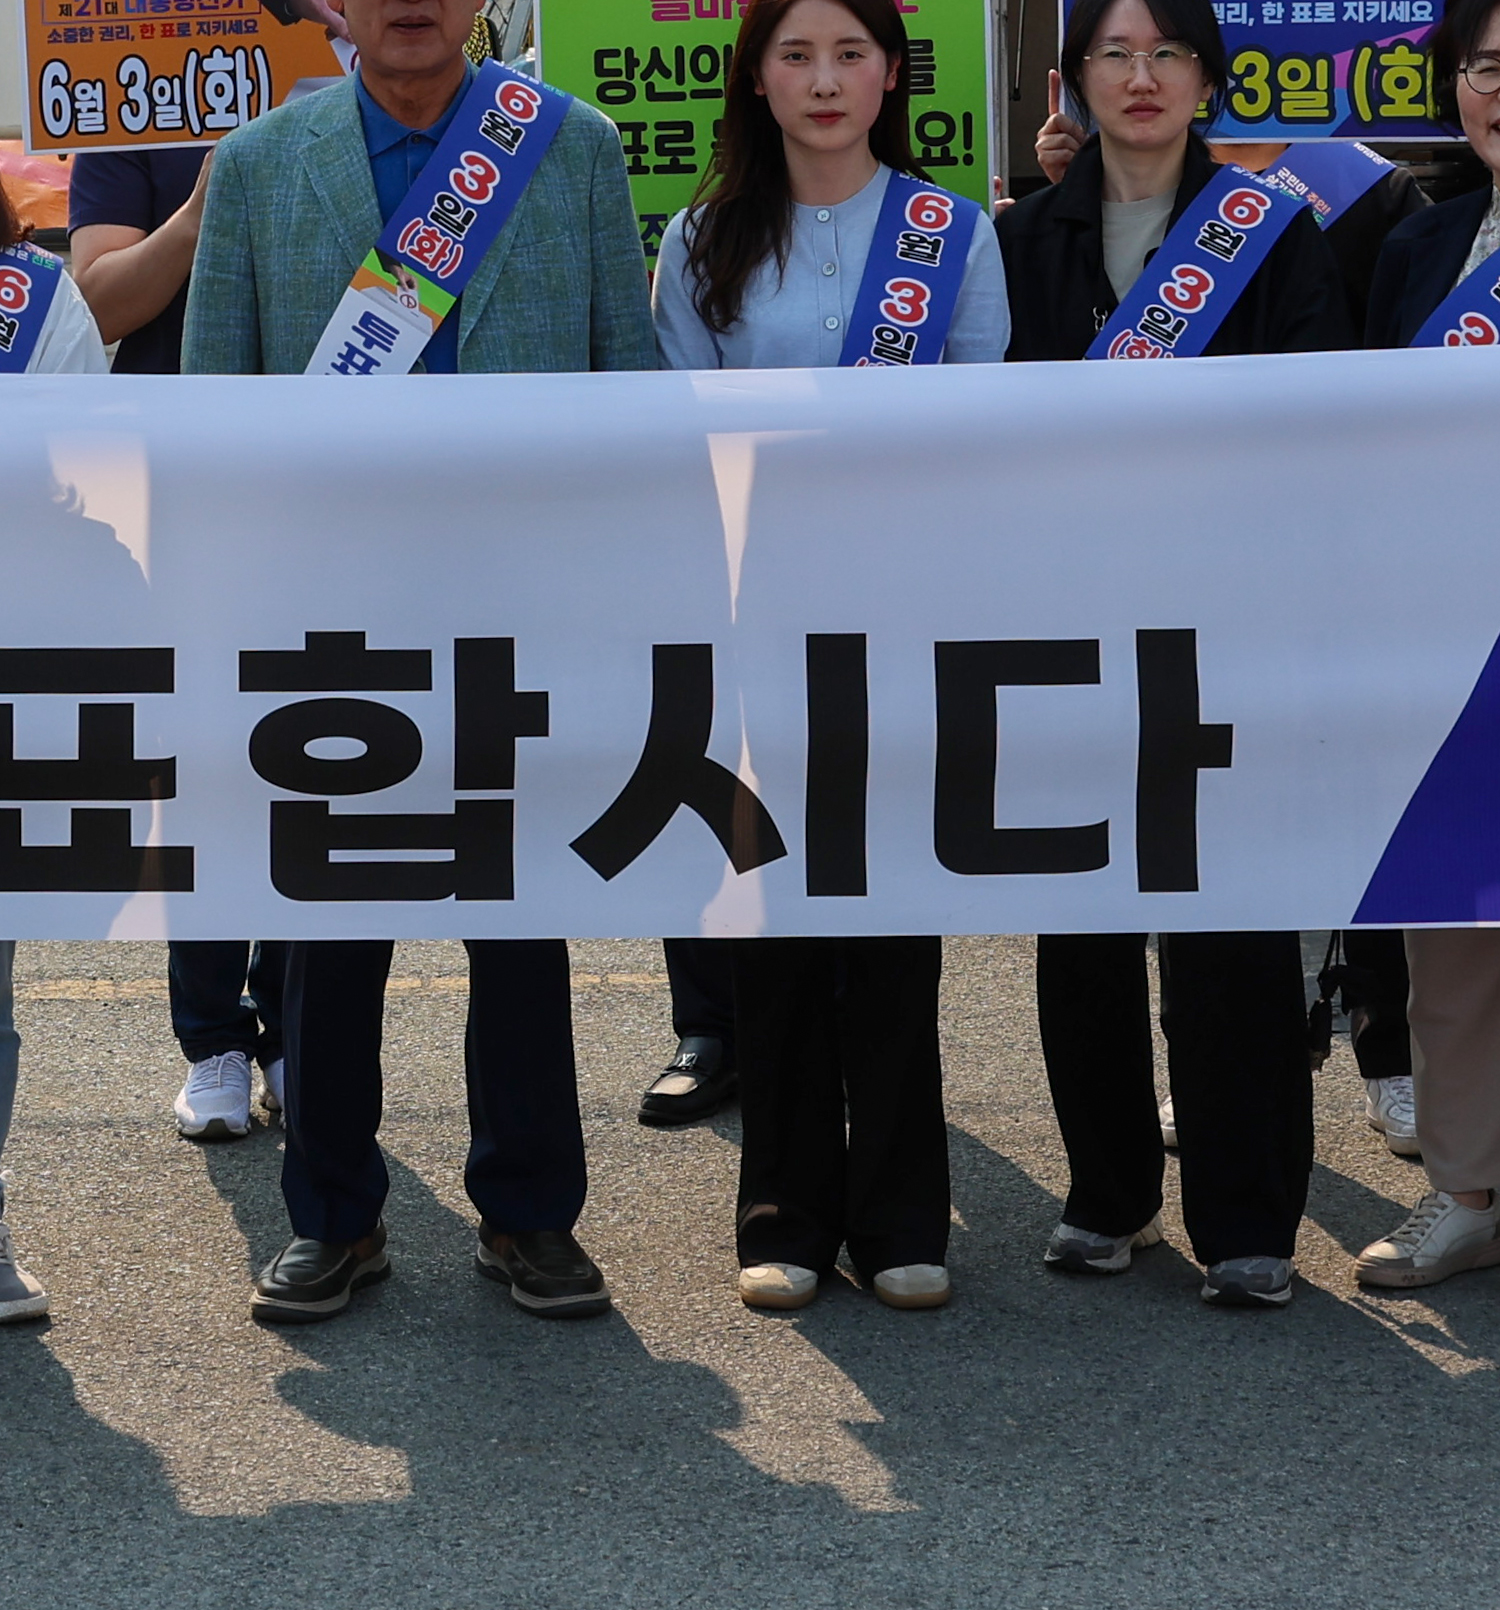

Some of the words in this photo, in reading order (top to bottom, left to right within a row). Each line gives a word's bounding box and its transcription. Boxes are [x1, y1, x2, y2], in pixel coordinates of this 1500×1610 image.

[47, 24, 95, 45] 소중한
[99, 22, 137, 44] 권리,
[139, 21, 156, 42] 한
[159, 19, 192, 40] 표로
[195, 16, 259, 39] 지키세요
[1262, 1, 1285, 25] 한
[1290, 2, 1336, 24] 표로
[1342, 1, 1434, 24] 지키세요
[40, 57, 107, 140] 6월
[479, 80, 543, 156] 6월
[896, 191, 954, 267] 6월
[1195, 187, 1272, 262] 6월
